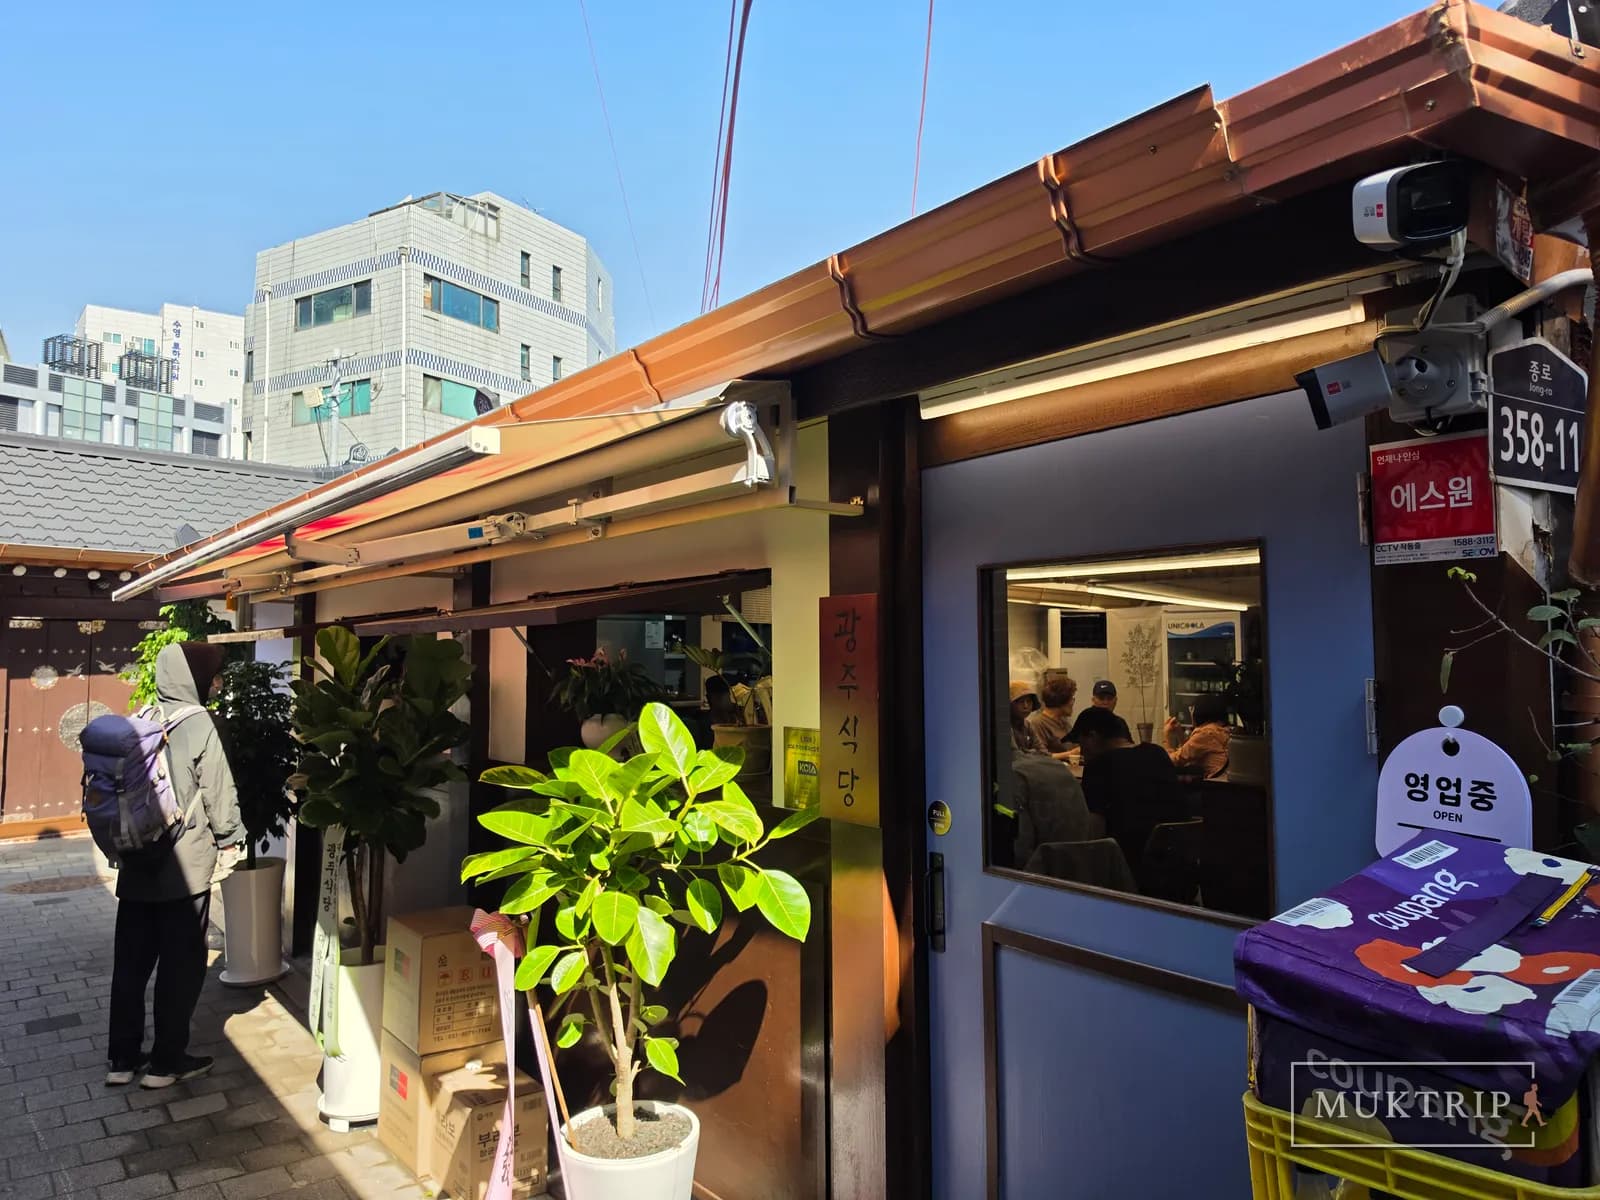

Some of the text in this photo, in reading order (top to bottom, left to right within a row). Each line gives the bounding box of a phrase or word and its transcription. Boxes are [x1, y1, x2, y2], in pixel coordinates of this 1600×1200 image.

[1528, 360, 1553, 382] 종로
[1529, 382, 1553, 396] Jong-ro
[1500, 405, 1579, 473] 358-11
[1376, 453, 1402, 466] 언제나
[1390, 476, 1473, 513] 에스원
[1375, 542, 1400, 553] CCTV
[1454, 535, 1495, 547] 1588-3112
[833, 607, 861, 808] 광주식당
[1404, 772, 1498, 812] 영업중
[1432, 809, 1463, 823] OPEN
